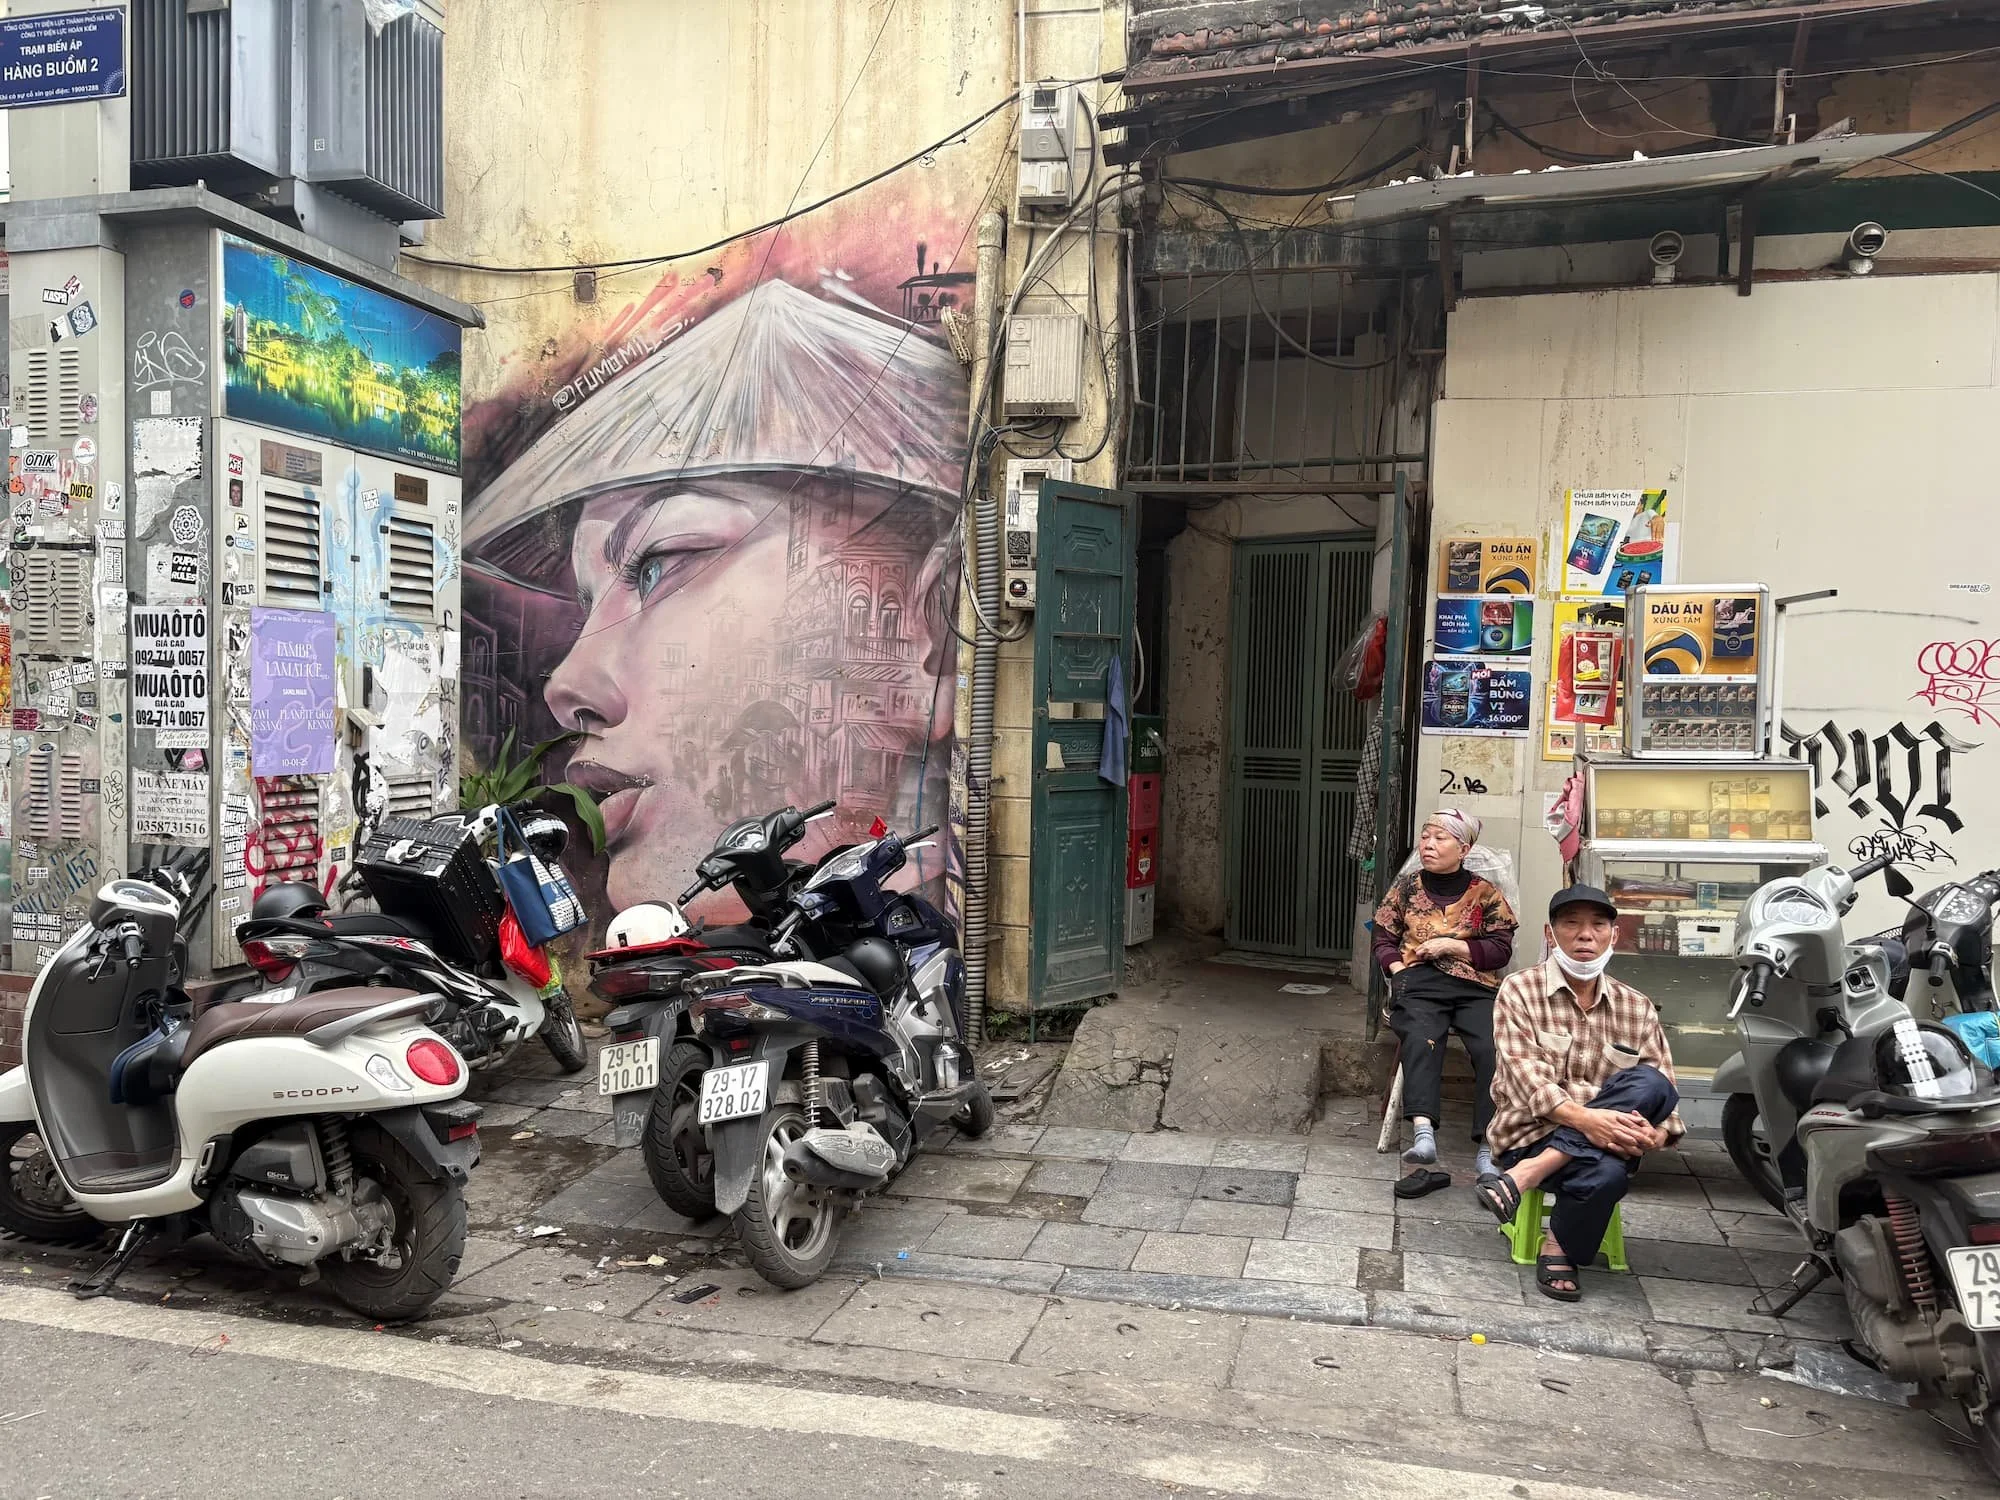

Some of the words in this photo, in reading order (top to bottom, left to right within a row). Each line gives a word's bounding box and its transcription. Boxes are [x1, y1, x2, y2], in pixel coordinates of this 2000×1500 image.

[20, 44, 45, 57] TRẠM
[47, 38, 67, 53] BIẾN
[70, 39, 82, 51] ÁP
[4, 61, 42, 81] HÀNG
[46, 54, 87, 76] BUỒM
[90, 57, 98, 72] 2
[171, 571, 196, 582] RULES
[1651, 601, 1679, 614] DẤU
[1683, 601, 1703, 614] ẤN
[170, 639, 185, 648] CAO
[135, 650, 153, 666] 092
[178, 650, 205, 666] 0057
[48, 665, 71, 681] FINCH
[71, 661, 94, 675] FINCH
[50, 677, 73, 691] BRIMZ
[73, 671, 96, 685] BRIMZ
[1489, 675, 1516, 687] BẤM
[47, 694, 70, 706] FINCH
[1489, 688, 1524, 699] BÙNG
[170, 700, 185, 708] CAO
[1490, 702, 1505, 713] VỊ
[47, 705, 69, 717] BRIMZ
[136, 709, 153, 726] 092
[156, 710, 175, 726] 714
[178, 710, 205, 727] 0057
[138, 777, 160, 788] MUA
[163, 778, 178, 789] XE
[181, 776, 206, 790] MÁY
[226, 811, 247, 823] MEOW
[137, 821, 206, 834] 0358731516
[225, 825, 247, 837] HONEE
[225, 840, 246, 853] MEOW
[223, 861, 246, 873] HONEE
[224, 877, 246, 890] MEOW
[13, 912, 36, 924] HONEE
[38, 912, 61, 925] HONEE
[13, 927, 36, 940] MEOW
[38, 930, 61, 943] MEOW
[608, 1042, 649, 1070] 29-C1
[602, 1063, 653, 1093] 910.01
[711, 1066, 758, 1095] 29-Y7
[273, 1085, 359, 1098] SCOOPY
[704, 1089, 761, 1120] 328.02
[1966, 1252, 2000, 1286] 29
